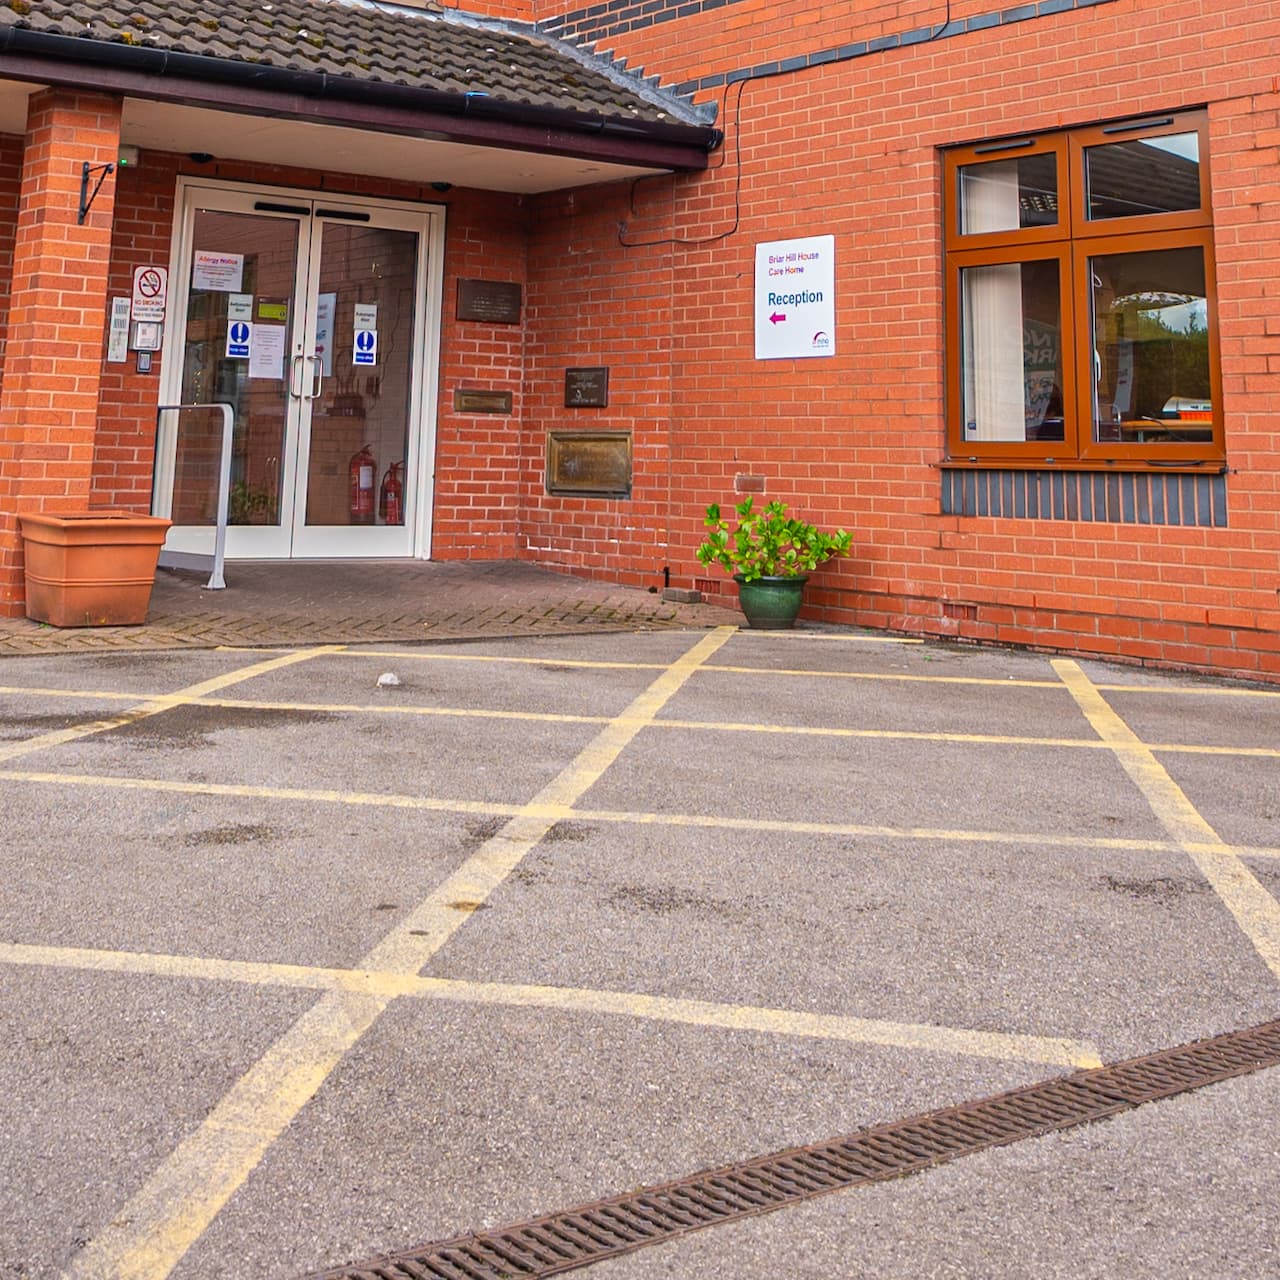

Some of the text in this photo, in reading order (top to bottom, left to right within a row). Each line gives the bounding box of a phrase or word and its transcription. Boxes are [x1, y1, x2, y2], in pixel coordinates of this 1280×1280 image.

[768, 251, 819, 264] Briar Hill House
[768, 265, 804, 276] Care Home
[768, 289, 823, 307] Reception
